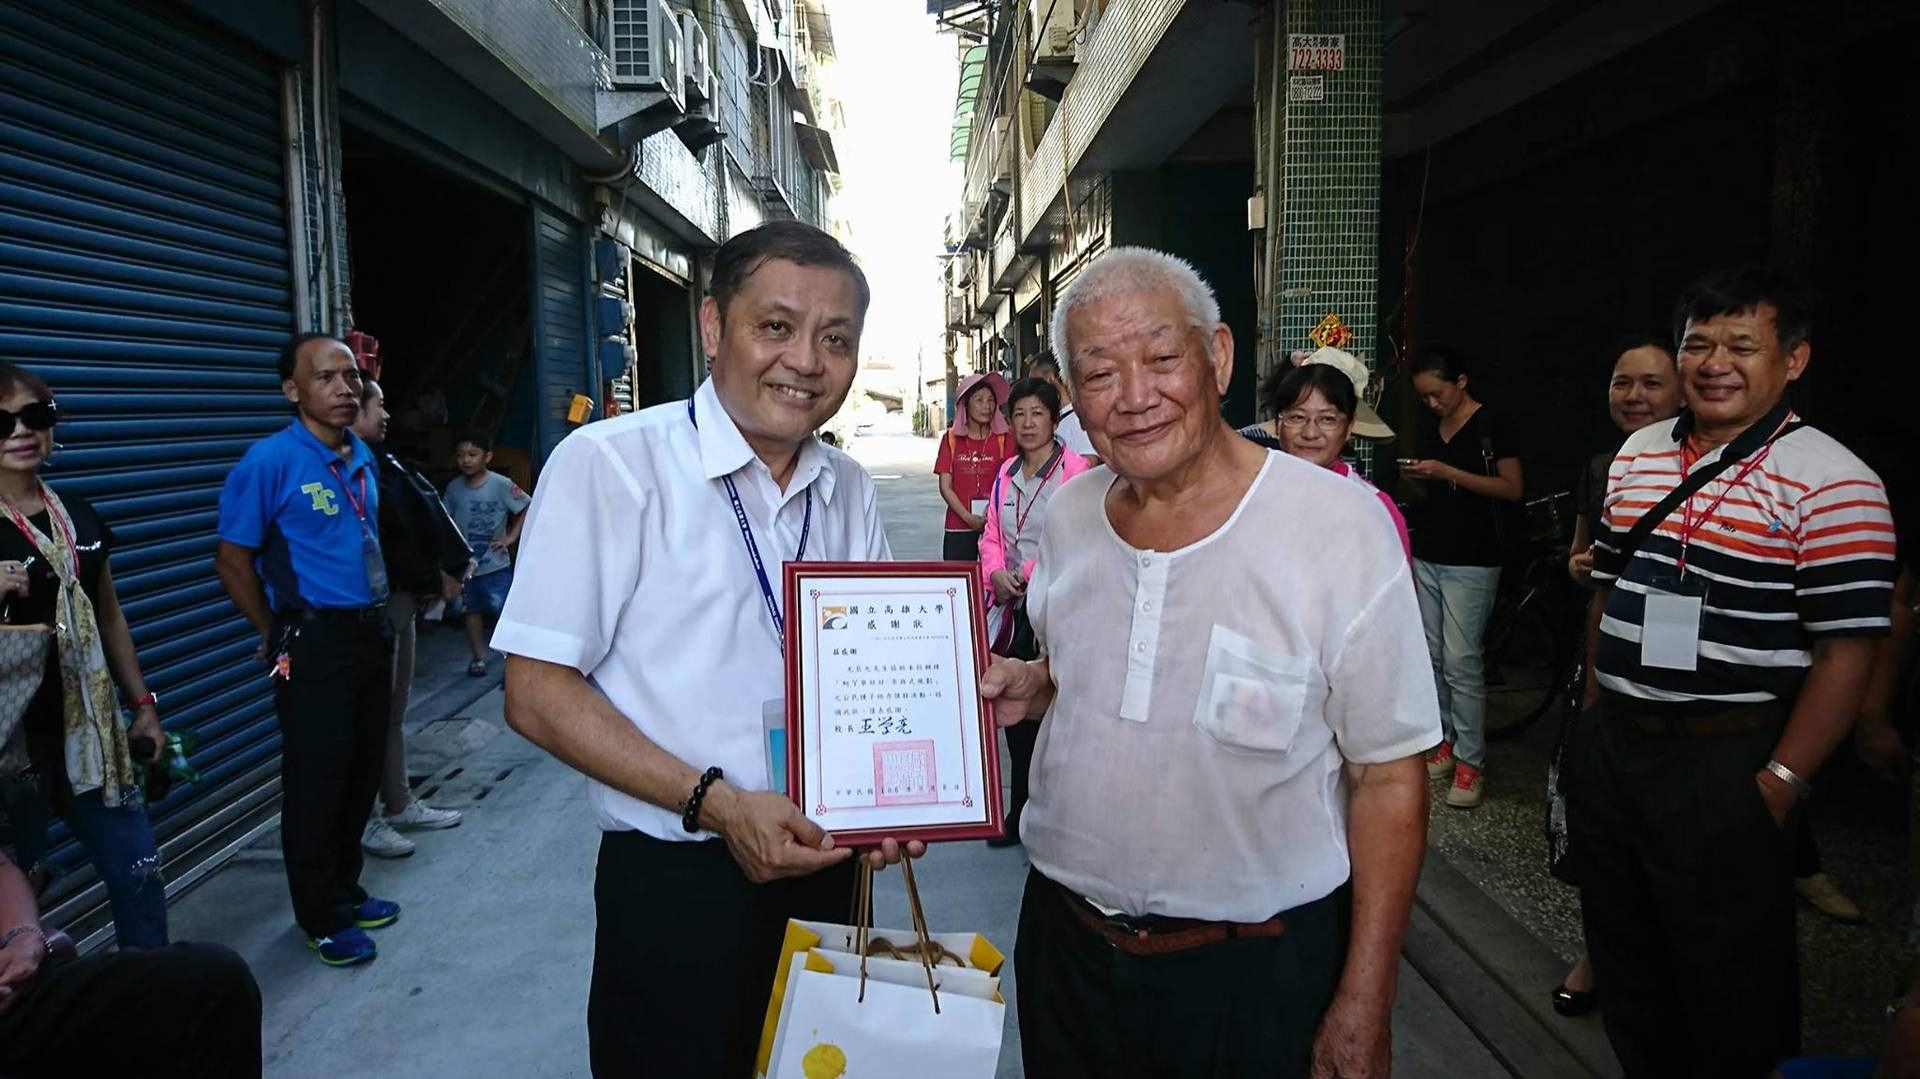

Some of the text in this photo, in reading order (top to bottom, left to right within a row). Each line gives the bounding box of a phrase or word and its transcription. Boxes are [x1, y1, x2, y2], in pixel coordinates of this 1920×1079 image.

[301, 482, 339, 516] TC
[849, 604, 944, 615] 國立高雄大學
[867, 620, 923, 630] 感謝狀
